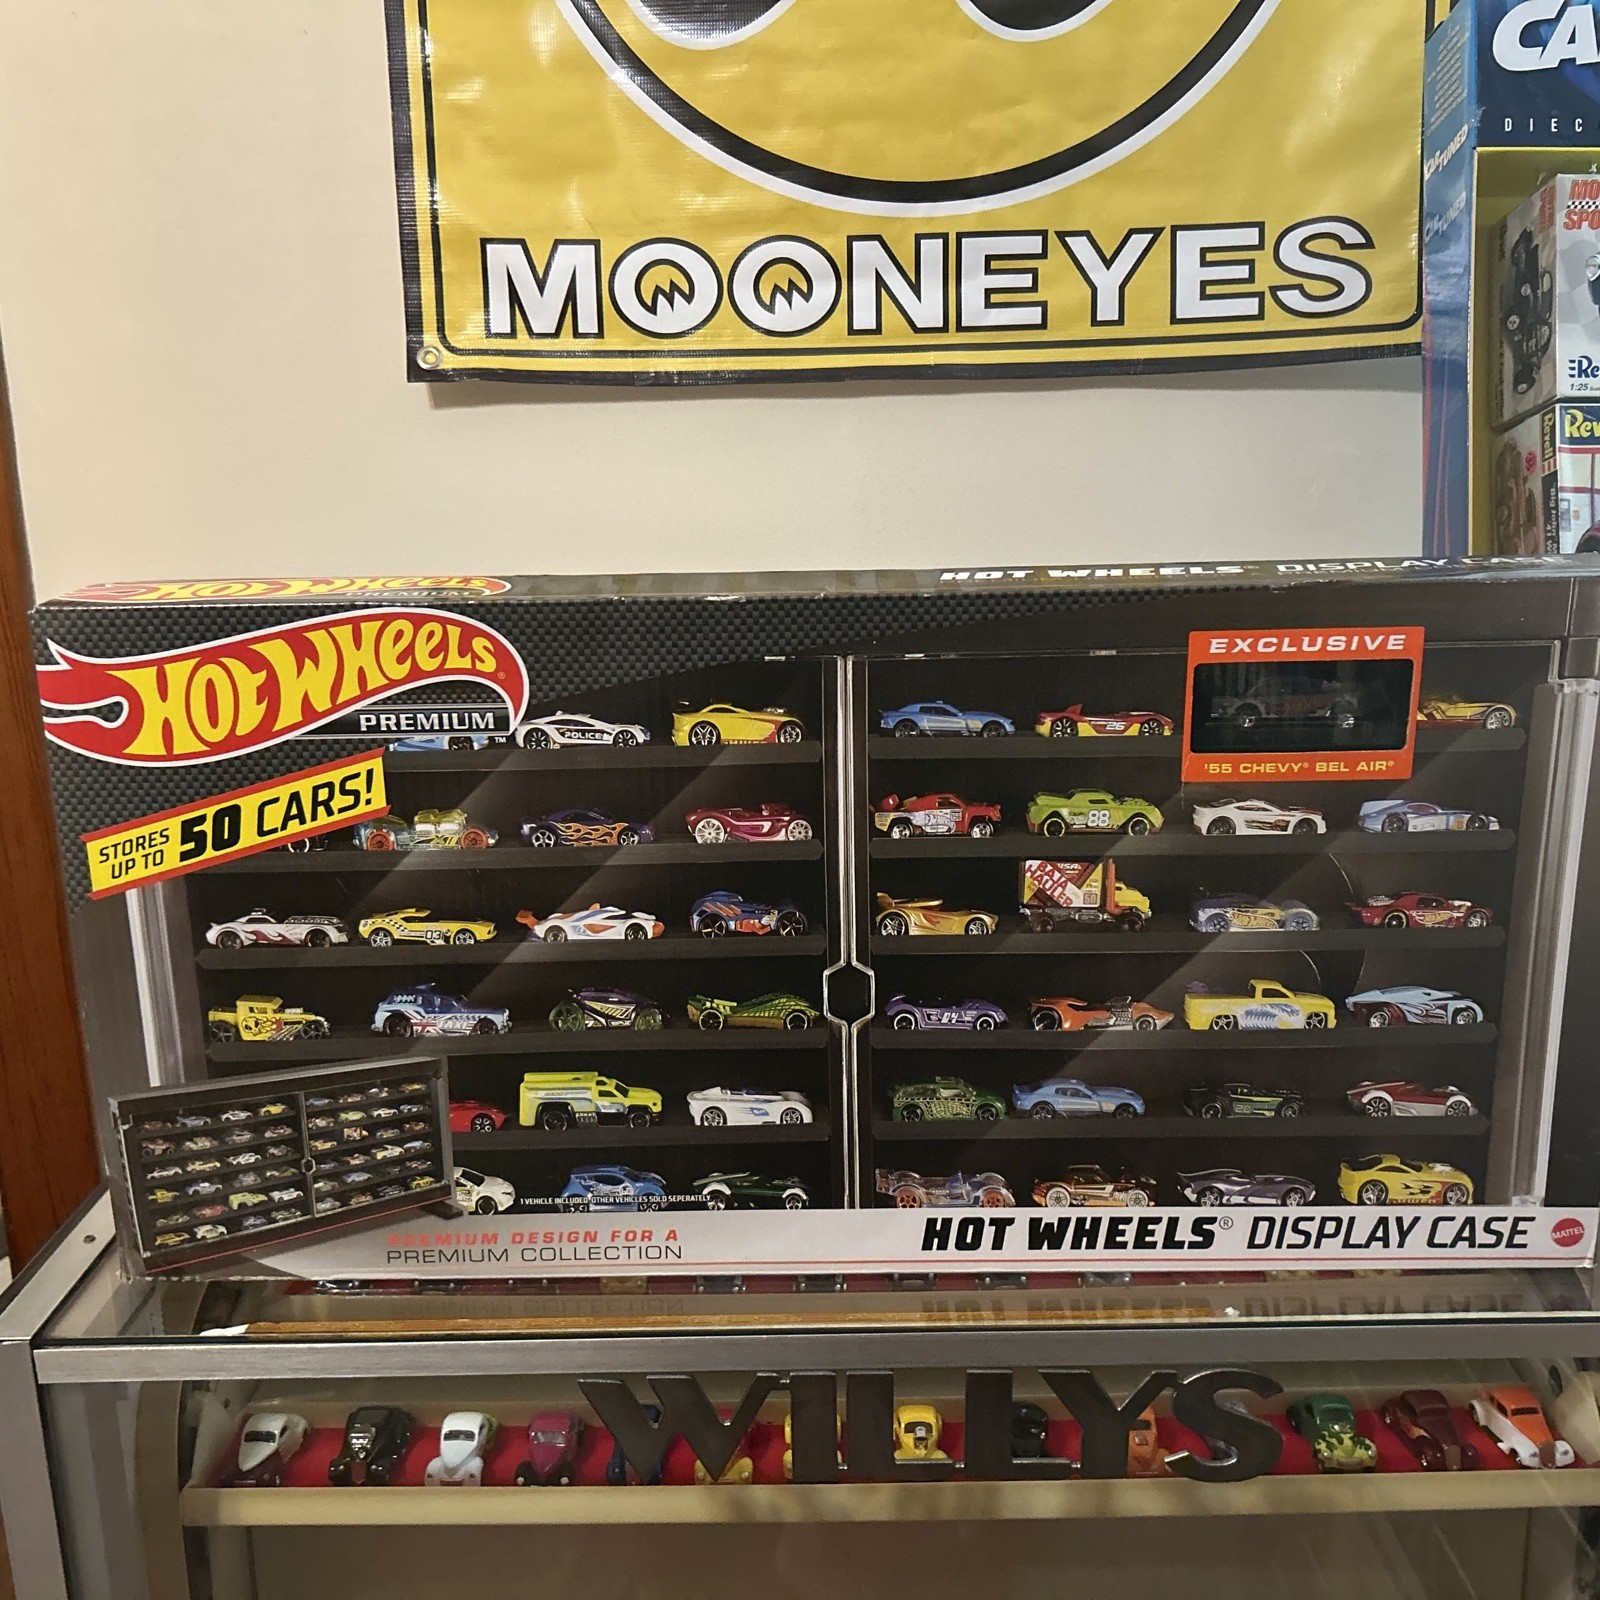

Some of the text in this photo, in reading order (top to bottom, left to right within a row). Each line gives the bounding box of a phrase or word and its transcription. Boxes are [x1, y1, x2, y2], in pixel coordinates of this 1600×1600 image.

[1492, 0, 1600, 71] CA
[483, 217, 1378, 340] MOONEYES
[1543, 412, 1554, 459] Revell
[939, 570, 1034, 581] HOT
[1277, 558, 1448, 573] DISPLAY
[1208, 634, 1407, 654] EXCLUSIVE
[359, 711, 496, 732] PREMIUM
[1105, 721, 1126, 731] 26
[1204, 762, 1233, 774] '55
[1315, 762, 1349, 773] BEL
[99, 768, 376, 865] STORES 50 CARS!
[1087, 808, 1112, 828] 88
[111, 848, 165, 880] UP TO
[1025, 864, 1073, 906] HAULER
[1036, 861, 1069, 893] BAJA
[424, 929, 441, 941] 03
[649, 1195, 666, 1203] SOLD
[387, 1229, 679, 1248] PREMIUM DESIGN FOR A
[921, 1217, 1016, 1252] HOT
[1246, 1215, 1422, 1250] DISPLAY
[1426, 1215, 1537, 1249] CASE
[1551, 1226, 1584, 1239] MATTEL
[387, 1245, 682, 1264] PREMIUM COLLECTION
[576, 1367, 1285, 1485] WILLYS
